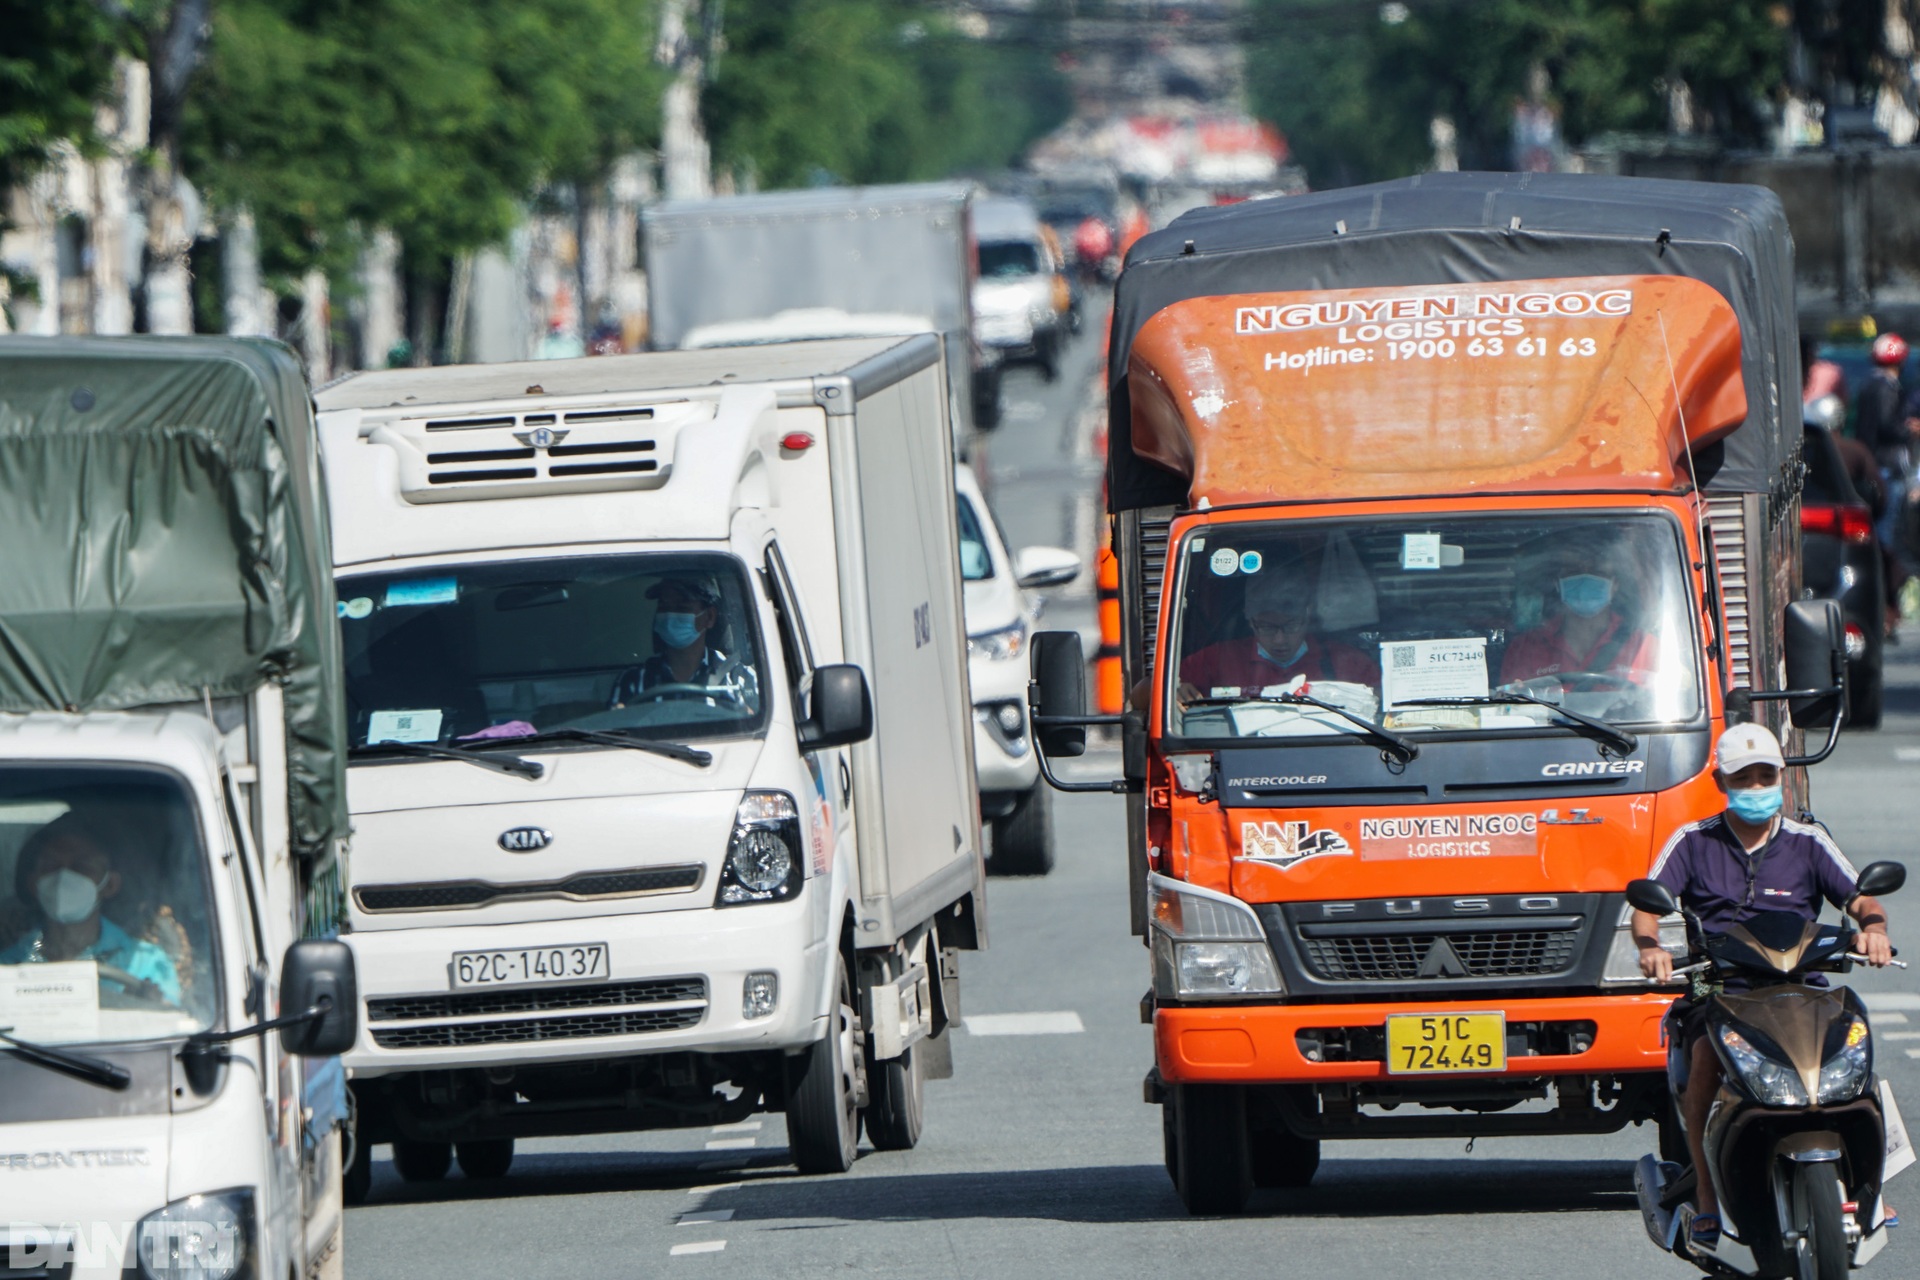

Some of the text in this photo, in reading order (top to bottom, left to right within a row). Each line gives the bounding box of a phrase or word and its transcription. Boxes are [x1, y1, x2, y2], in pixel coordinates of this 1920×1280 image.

[1236, 290, 1632, 334] NGUYEN NGOC
[1338, 318, 1525, 344] LOGISTICS
[1264, 337, 1597, 371] Hotline: 1900 63 61 63
[1429, 651, 1484, 663] 51C72449
[1541, 760, 1645, 776] CANTER
[1228, 775, 1327, 787] INTERCOOLER
[1361, 813, 1537, 839] NGUYEN NGOC
[503, 830, 546, 850] KIA
[1407, 841, 1492, 858] LOGISTICS
[1322, 897, 1560, 917] FUSO
[1421, 1017, 1471, 1041] 51C
[1402, 1044, 1492, 1069] 724.49
